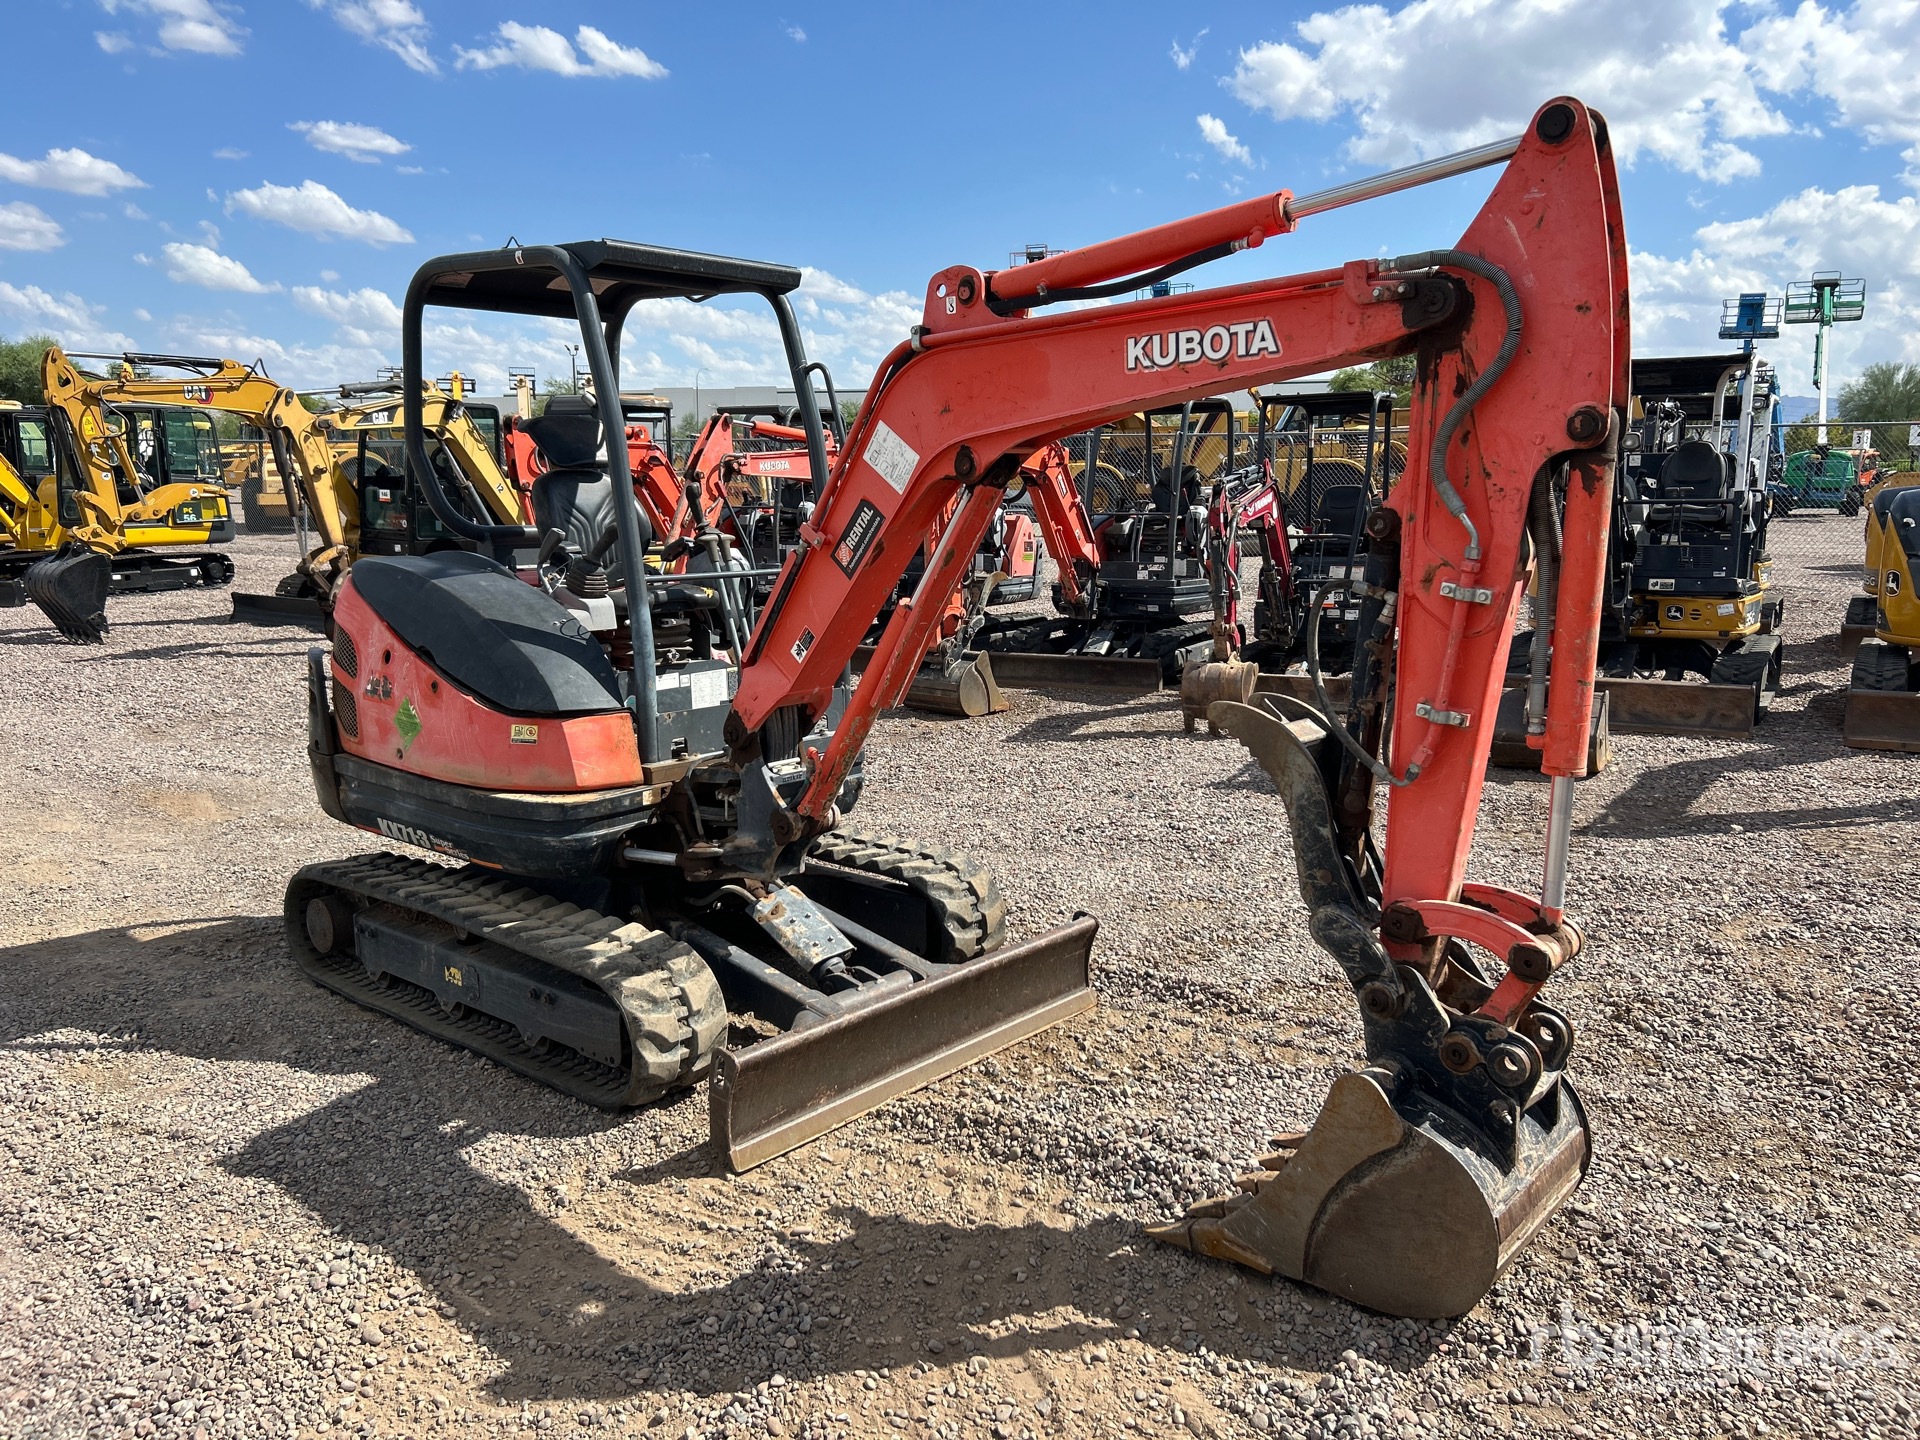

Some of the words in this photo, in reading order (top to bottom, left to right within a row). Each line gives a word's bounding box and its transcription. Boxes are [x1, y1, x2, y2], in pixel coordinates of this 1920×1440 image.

[1126, 319, 1278, 370] KUBOTA
[183, 385, 206, 400] CAT
[372, 411, 389, 425] CAT
[760, 460, 790, 471] KUBOTA
[845, 506, 874, 550] RENTAL
[377, 817, 432, 849] KX71-3
